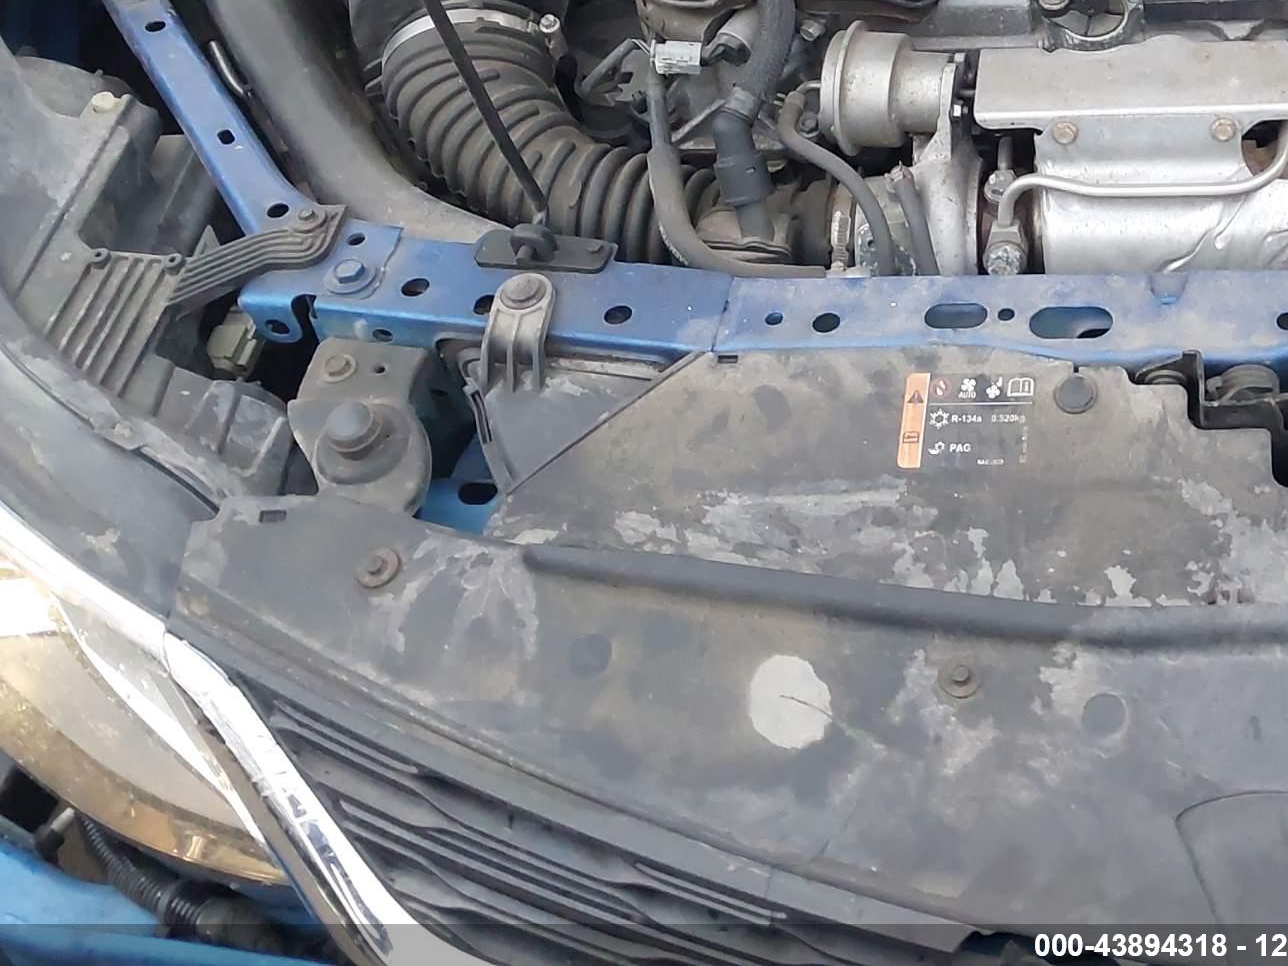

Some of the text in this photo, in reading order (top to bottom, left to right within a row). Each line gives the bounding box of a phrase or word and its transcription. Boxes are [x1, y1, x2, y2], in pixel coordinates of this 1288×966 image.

[958, 391, 977, 399] AUTO
[951, 414, 982, 423] R-134a
[949, 443, 971, 452] PAG
